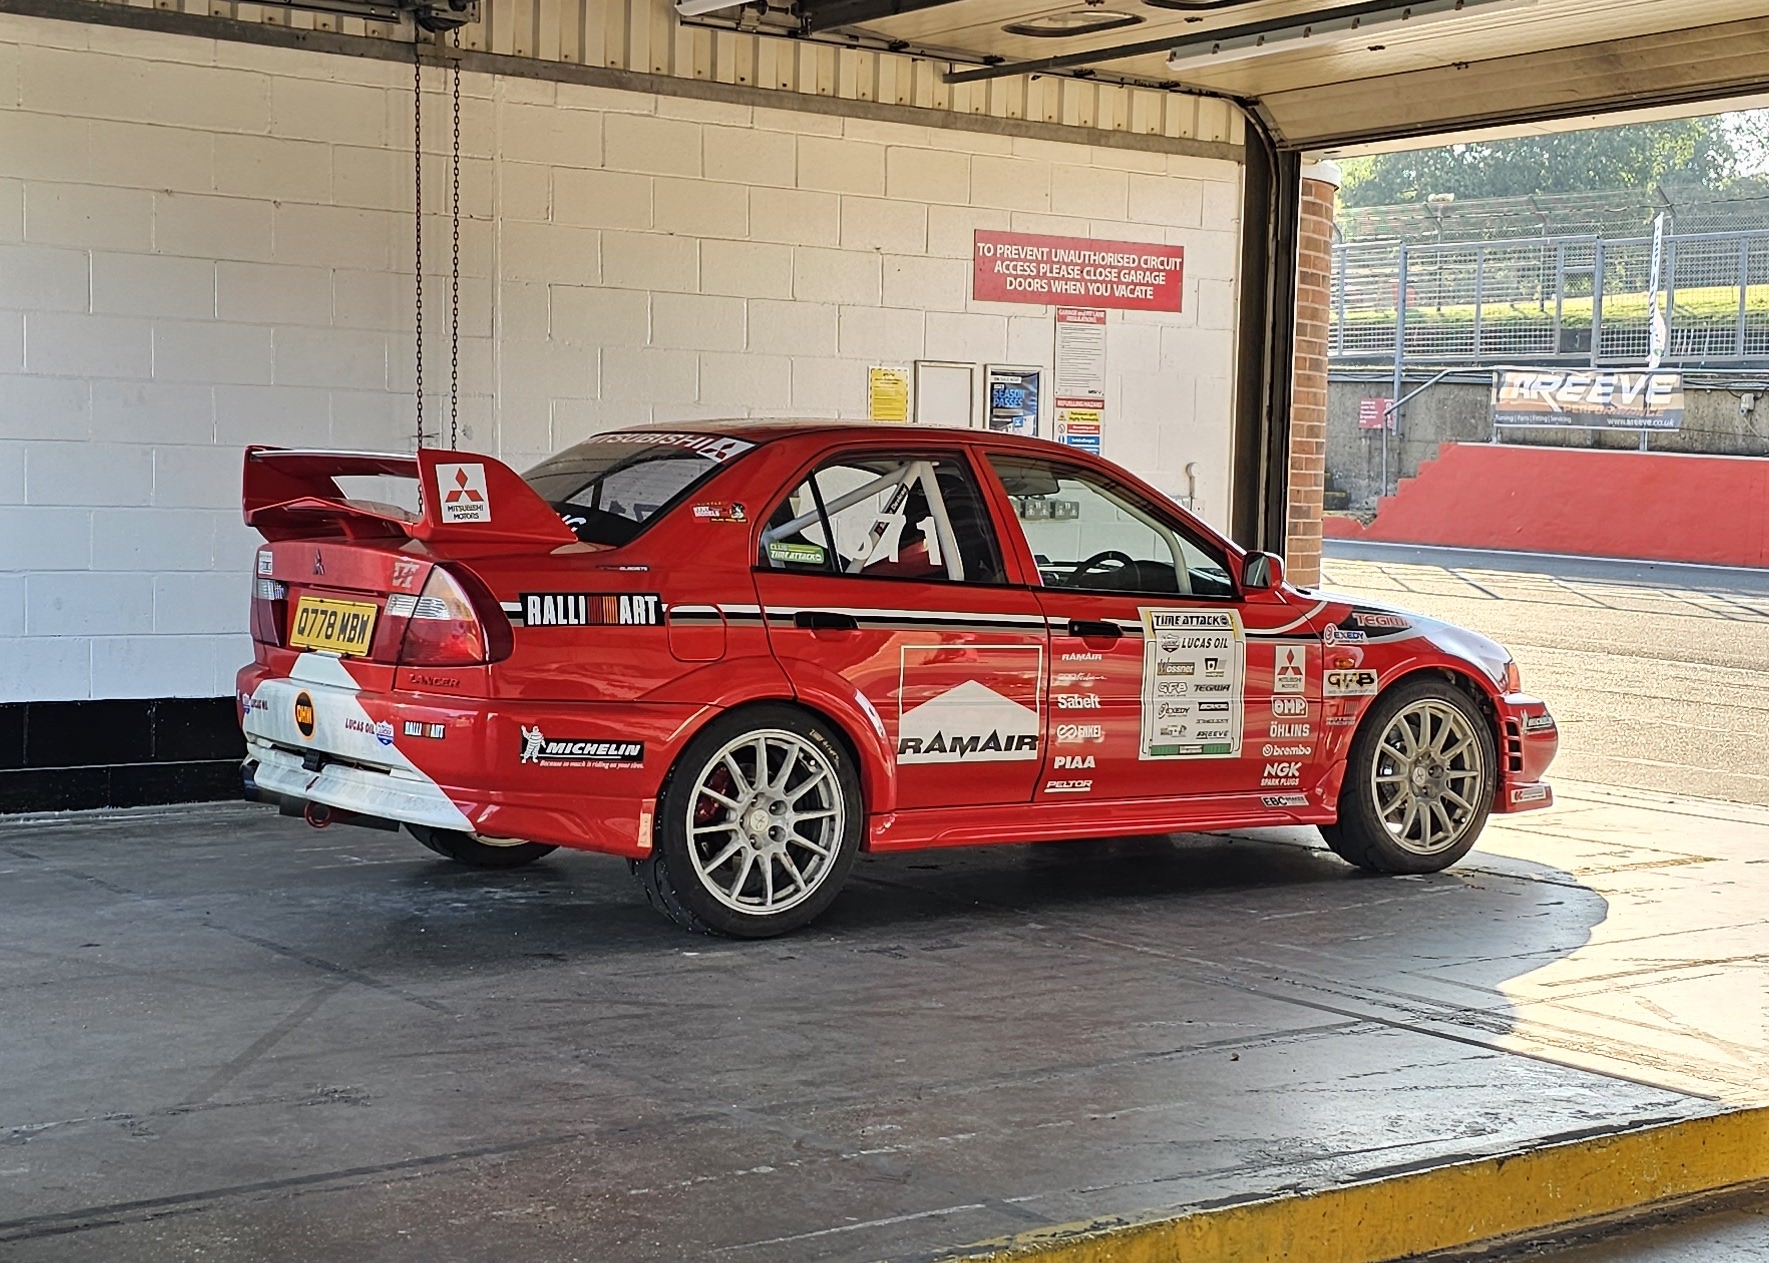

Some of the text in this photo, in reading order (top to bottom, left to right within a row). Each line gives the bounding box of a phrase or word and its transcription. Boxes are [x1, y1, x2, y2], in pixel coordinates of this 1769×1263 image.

[977, 243, 1182, 271] TO PREVENT UNAUTHORISED CIRCUIT
[994, 261, 1166, 285] ACCESS PLEASE CLOSE GARAGE
[1006, 277, 1154, 299] DOORS WHEN YOU VACATE
[993, 389, 1024, 398] SEASON
[993, 399, 1023, 408] PASSES
[583, 434, 715, 449] TSUBISHI
[527, 595, 658, 625] RALLI ART
[297, 608, 338, 639] Q778
[1354, 614, 1410, 626] TEGIW
[1334, 631, 1364, 640] EXEDY
[1181, 638, 1212, 648] LUCAS
[1214, 638, 1228, 648] OIL
[1062, 652, 1102, 661] RAMAIR
[409, 674, 461, 688] LANCER
[1058, 693, 1101, 708] Sabelt
[345, 718, 364, 733] LUCAS
[365, 724, 375, 734] OIL
[1269, 721, 1310, 737] ÖHLINS
[545, 742, 641, 756] MICHELIN
[897, 729, 1038, 758] RAMAIR
[1273, 744, 1311, 755] brembo
[1054, 756, 1096, 769] PIAA
[1263, 761, 1302, 777] NGK
[1046, 780, 1093, 788] PELTOR
[1261, 778, 1299, 786] SPARK PLUGS
[1263, 796, 1287, 806] EBC
